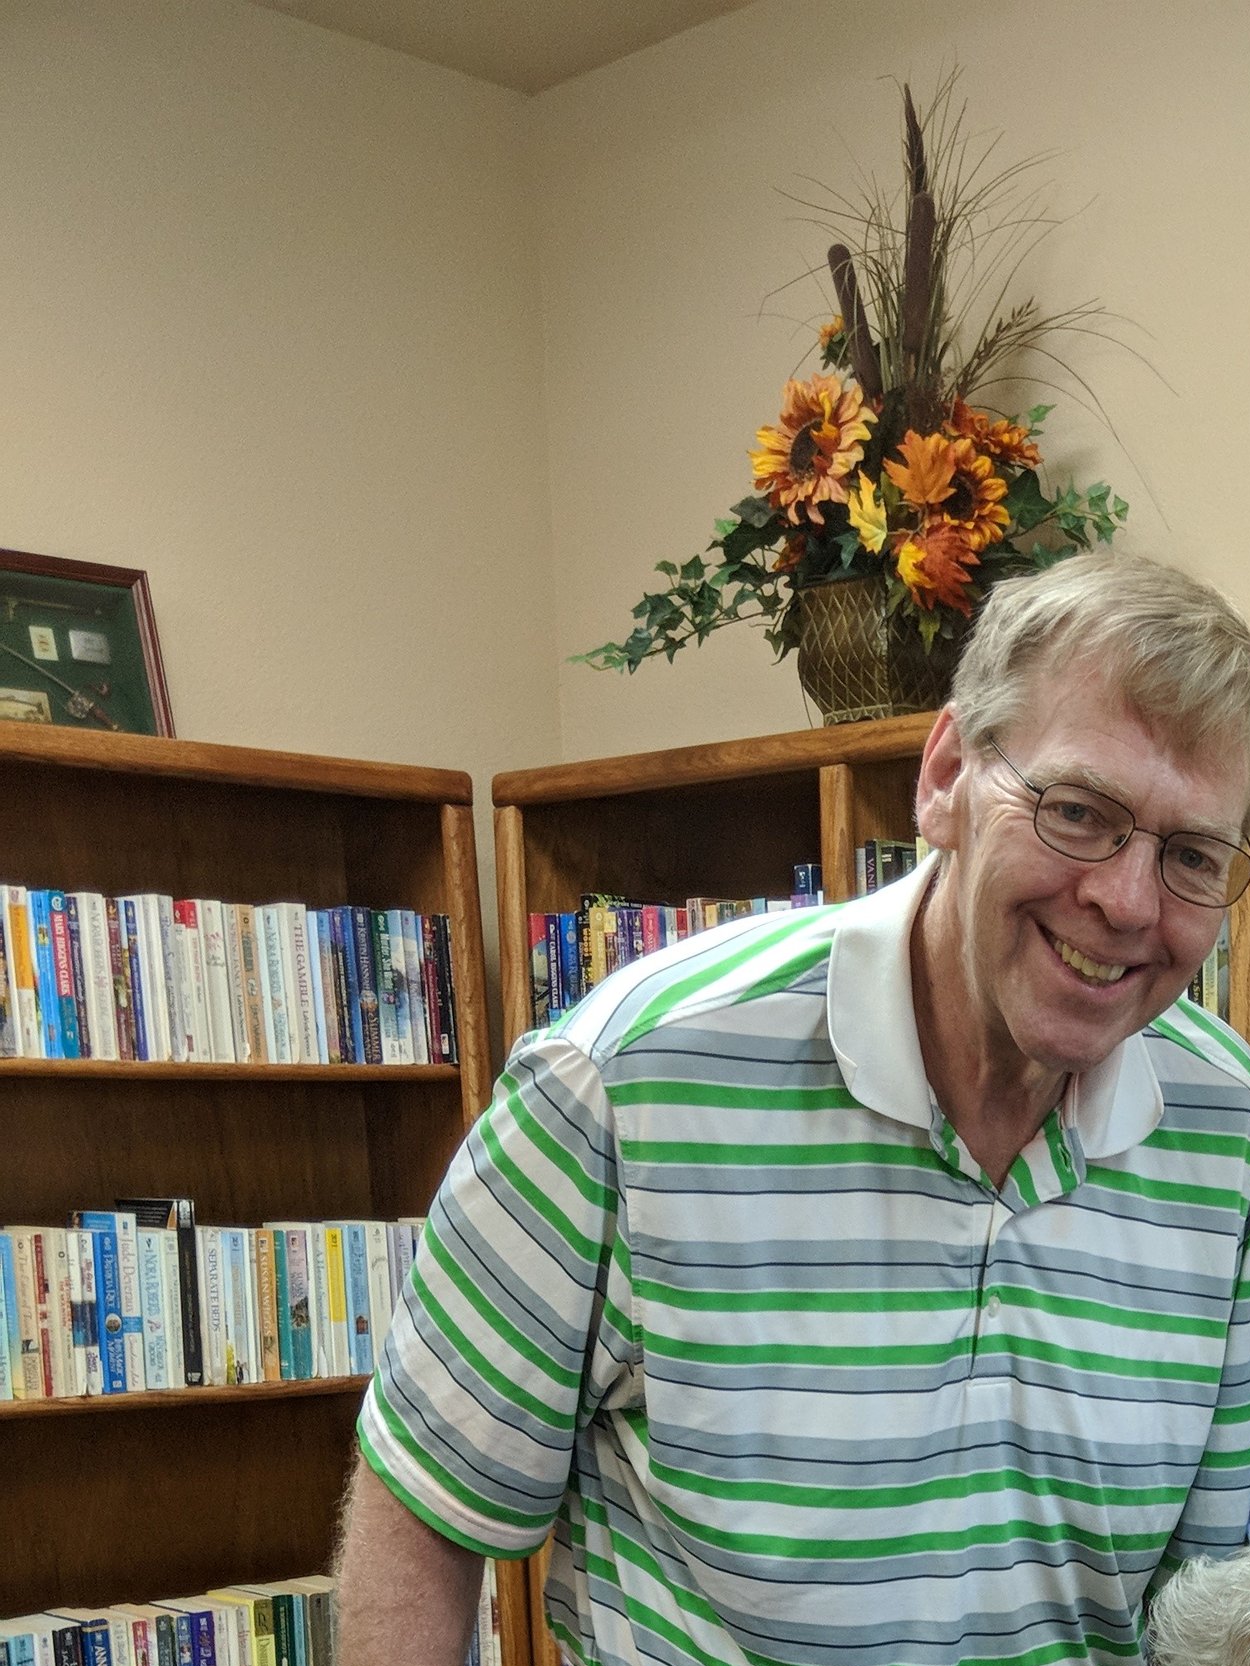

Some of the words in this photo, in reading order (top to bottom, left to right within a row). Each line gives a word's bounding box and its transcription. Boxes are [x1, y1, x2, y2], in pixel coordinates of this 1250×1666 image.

[867, 858, 875, 889] VANI
[54, 914, 64, 936] MARY
[294, 924, 304, 954] THE
[56, 937, 68, 968] HIGGINS
[358, 928, 368, 956] KRISTIN
[60, 971, 72, 996] CLARK
[233, 959, 242, 988] FANCY
[296, 954, 309, 1007] GAMBLE
[360, 956, 372, 990] HANNAH
[550, 962, 558, 987] HIGGINS
[368, 1014, 380, 1060] SUMMER
[120, 1238, 135, 1264] Jude
[104, 1254, 115, 1290] PATRICIA
[146, 1254, 158, 1280] NORA
[208, 1248, 218, 1302] SEPARATE
[260, 1256, 268, 1293] SUSAN
[106, 1290, 116, 1309] RICE
[122, 1266, 138, 1312] Deveraux
[147, 1282, 160, 1316] ROBERTS
[211, 1305, 220, 1332] BEDS
[262, 1294, 272, 1336] WIGGS
